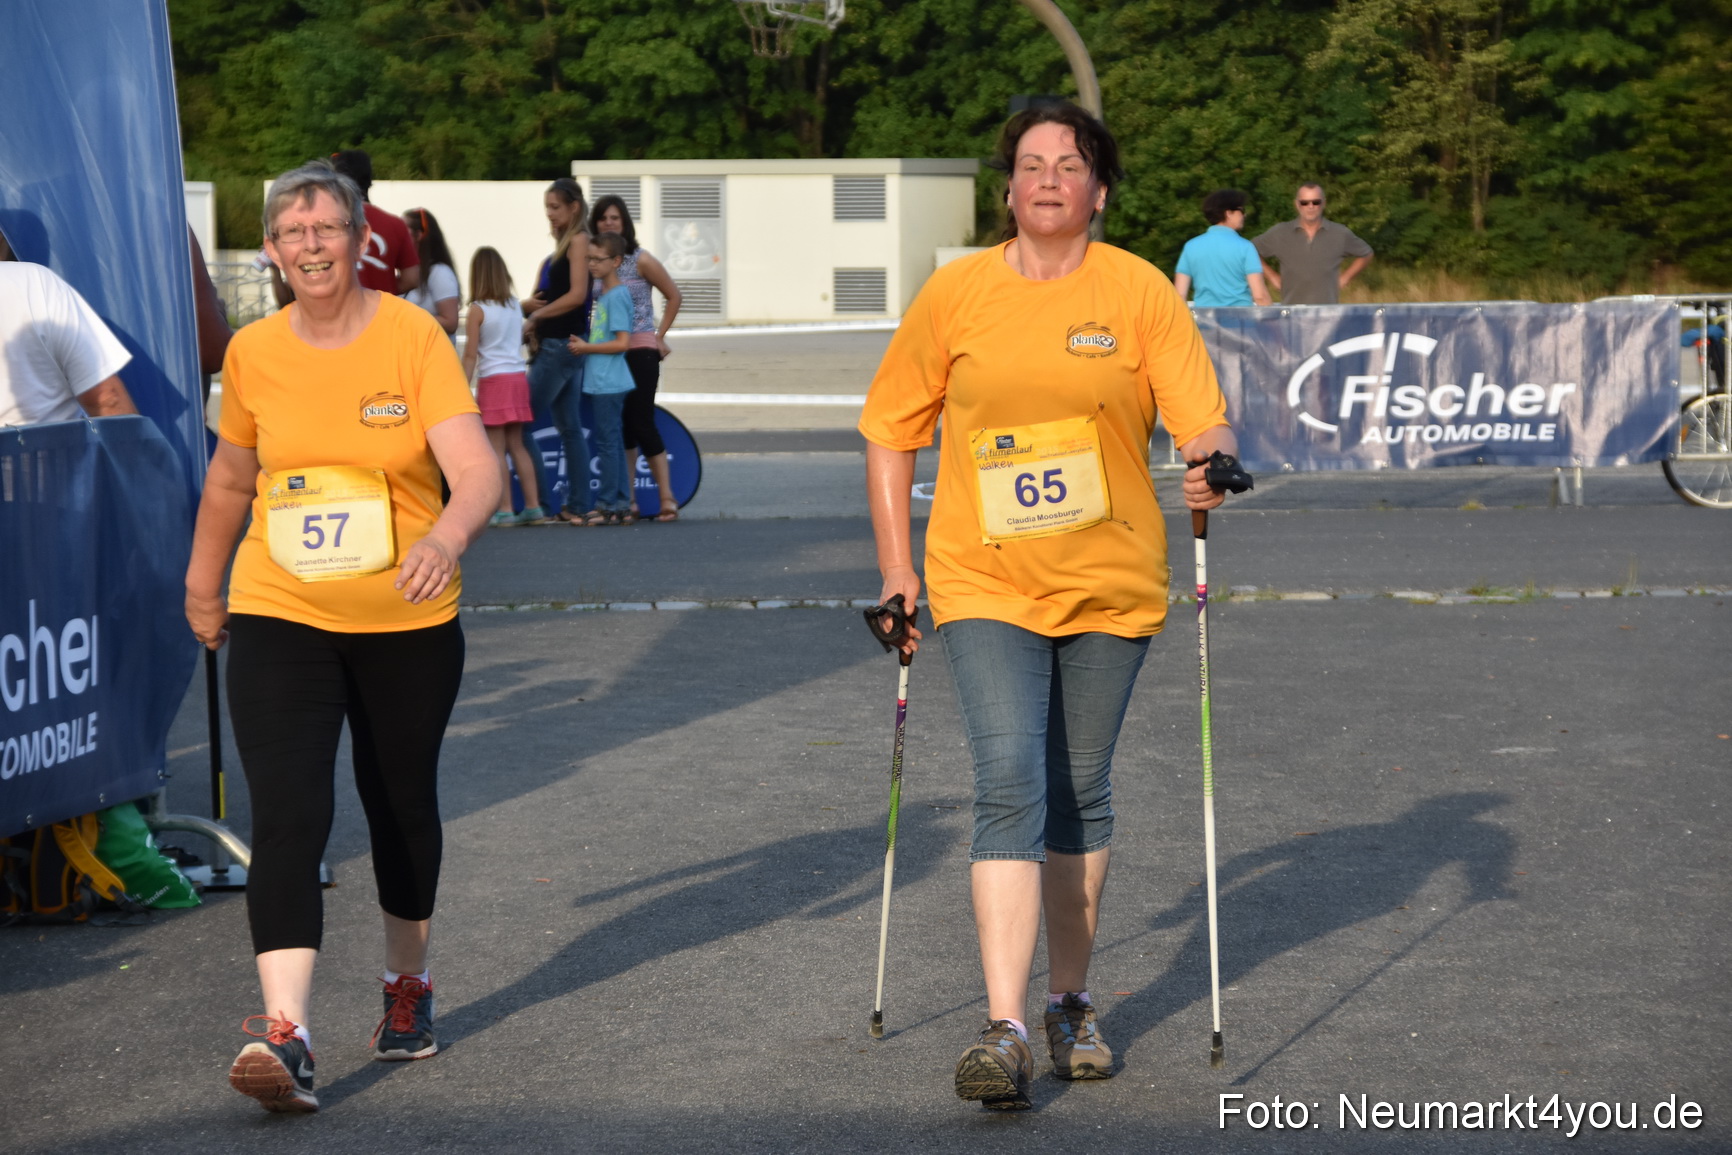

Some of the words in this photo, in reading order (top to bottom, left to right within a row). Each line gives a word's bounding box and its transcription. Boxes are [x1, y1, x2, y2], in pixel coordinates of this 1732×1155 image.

[1340, 372, 1576, 418] Fischer
[1361, 423, 1556, 445] AUTOMOBILE
[989, 444, 1033, 458] firmenlauf
[979, 460, 1014, 471] walken
[1014, 468, 1068, 507] 65
[269, 501, 302, 512] walken
[1006, 514, 1037, 525] Claudia
[1036, 508, 1085, 522] Moosburger
[302, 512, 350, 550] 57
[295, 557, 327, 566] Jeanette
[328, 555, 362, 563] Kirchner
